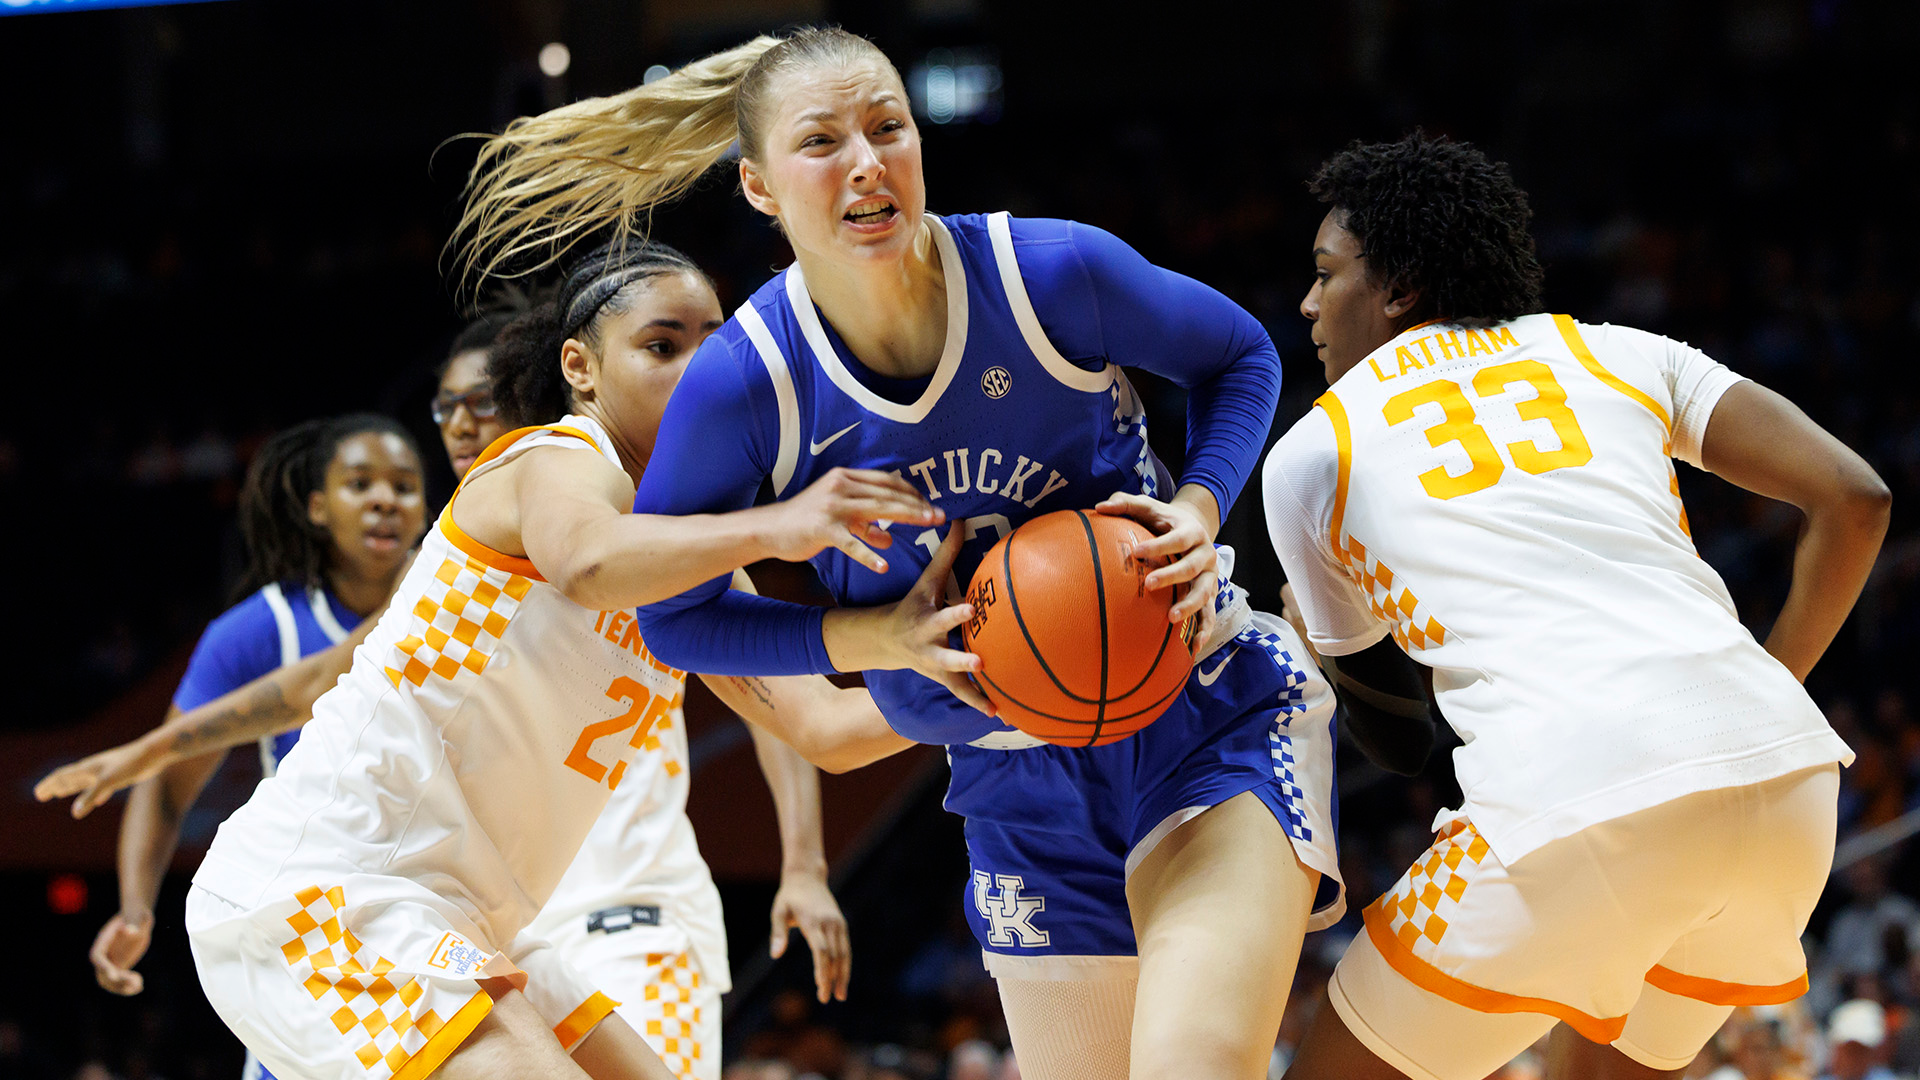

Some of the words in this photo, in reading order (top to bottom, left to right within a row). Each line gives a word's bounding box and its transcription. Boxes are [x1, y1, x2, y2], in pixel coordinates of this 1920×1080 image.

[983, 368, 1010, 397] SEC
[1368, 326, 1520, 382] LATHAM
[1382, 359, 1594, 501] 33
[888, 448, 1069, 509] TUCKY
[973, 869, 1051, 948] UK
